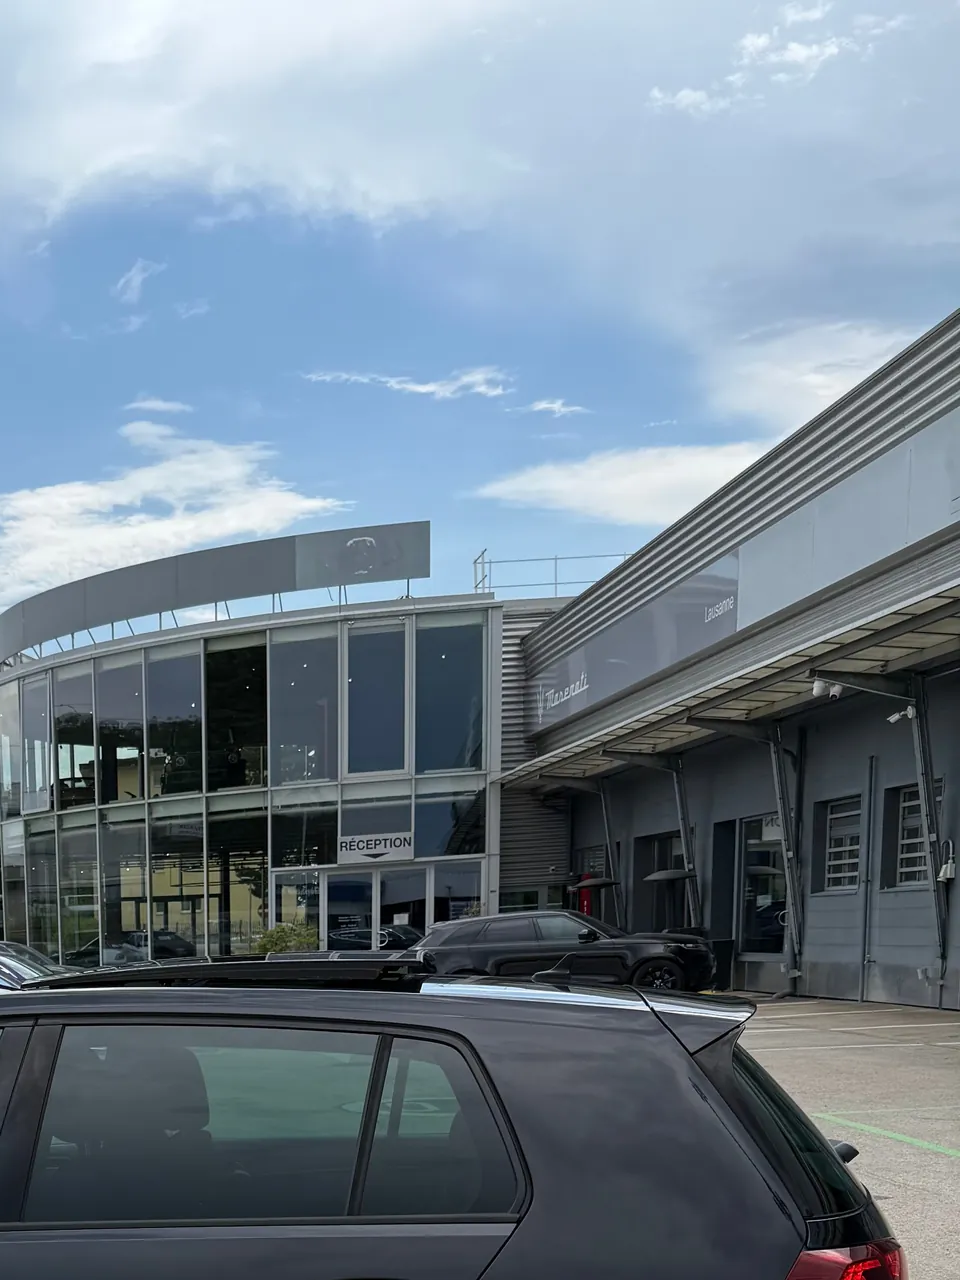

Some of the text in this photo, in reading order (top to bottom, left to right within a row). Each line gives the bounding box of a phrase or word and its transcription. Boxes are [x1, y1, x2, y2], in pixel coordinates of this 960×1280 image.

[704, 595, 735, 623] Lausanne
[545, 671, 590, 710] Maserati
[339, 836, 412, 852] RÉCEPTION
